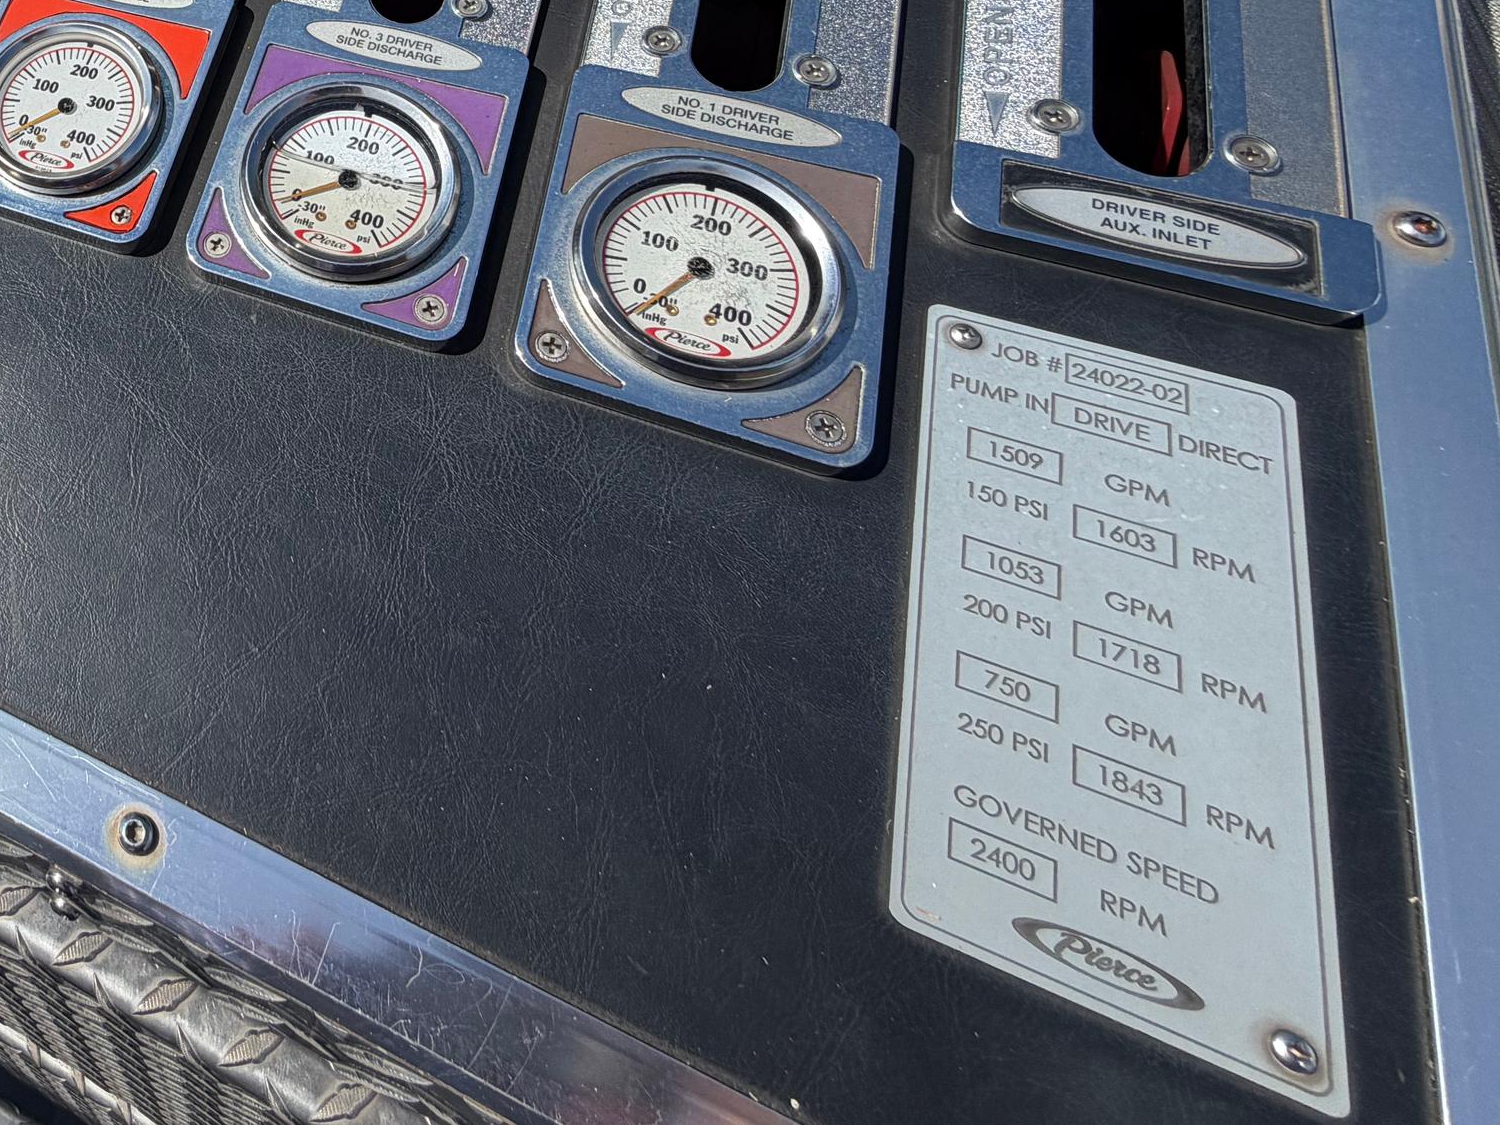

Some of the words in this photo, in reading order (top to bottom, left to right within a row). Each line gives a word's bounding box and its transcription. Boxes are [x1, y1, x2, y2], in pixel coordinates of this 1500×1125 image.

[336, 34, 364, 50] SIDE
[367, 40, 442, 66] DISCHARGE
[351, 27, 373, 41] NO.
[376, 32, 384, 42] 3
[386, 34, 433, 53] DRIVER
[982, 6, 1014, 87] OPEN
[32, 78, 60, 93] 100
[70, 64, 98, 79] 200
[86, 95, 115, 111] 300
[678, 95, 702, 110] NO.
[709, 102, 715, 113] 1
[721, 103, 780, 126] DRIVER
[67, 129, 96, 146] 400
[661, 104, 696, 122] SIDE
[700, 111, 794, 141] DISCHARGE
[346, 136, 380, 155] 200
[349, 209, 384, 229] 400
[690, 214, 732, 236] 200
[1091, 197, 1166, 223] DRIVER
[1173, 215, 1221, 236] SIDE
[1100, 217, 1147, 238] AUX.
[1153, 227, 1213, 251] INLET
[640, 230, 679, 253] 100
[726, 257, 768, 281] 300
[991, 343, 1039, 368] JOB
[1047, 356, 1062, 373] #
[1071, 362, 1182, 406] 24022-02
[949, 373, 1019, 405] PUMP
[1025, 392, 1049, 414] IN
[1074, 406, 1152, 443] DRIVE
[1178, 435, 1274, 475] DIRECT
[988, 438, 1044, 470] 1509
[1104, 473, 1170, 508] GPM
[966, 480, 1007, 508] 150
[1014, 495, 1048, 521] PSI
[1096, 518, 1157, 553] 1603
[1192, 547, 1256, 584] RPM
[986, 550, 1045, 586] 1053
[1104, 590, 1174, 630] GPM
[963, 594, 1008, 624] 200
[1015, 610, 1052, 639] PSI
[1097, 635, 1161, 675] 1718
[1200, 673, 1268, 714] RPM
[982, 670, 1031, 703] 750
[1104, 713, 1177, 757] GPM
[957, 712, 1004, 745] 250
[1013, 731, 1049, 764] PSI
[1097, 764, 1164, 807] 1843
[1205, 804, 1275, 850] RPM
[953, 784, 1118, 865] GOVERNED
[1126, 851, 1220, 905] SPEED
[969, 837, 1036, 883] 2400
[1100, 888, 1168, 937] RPM
[1052, 931, 1158, 992] Pierce
